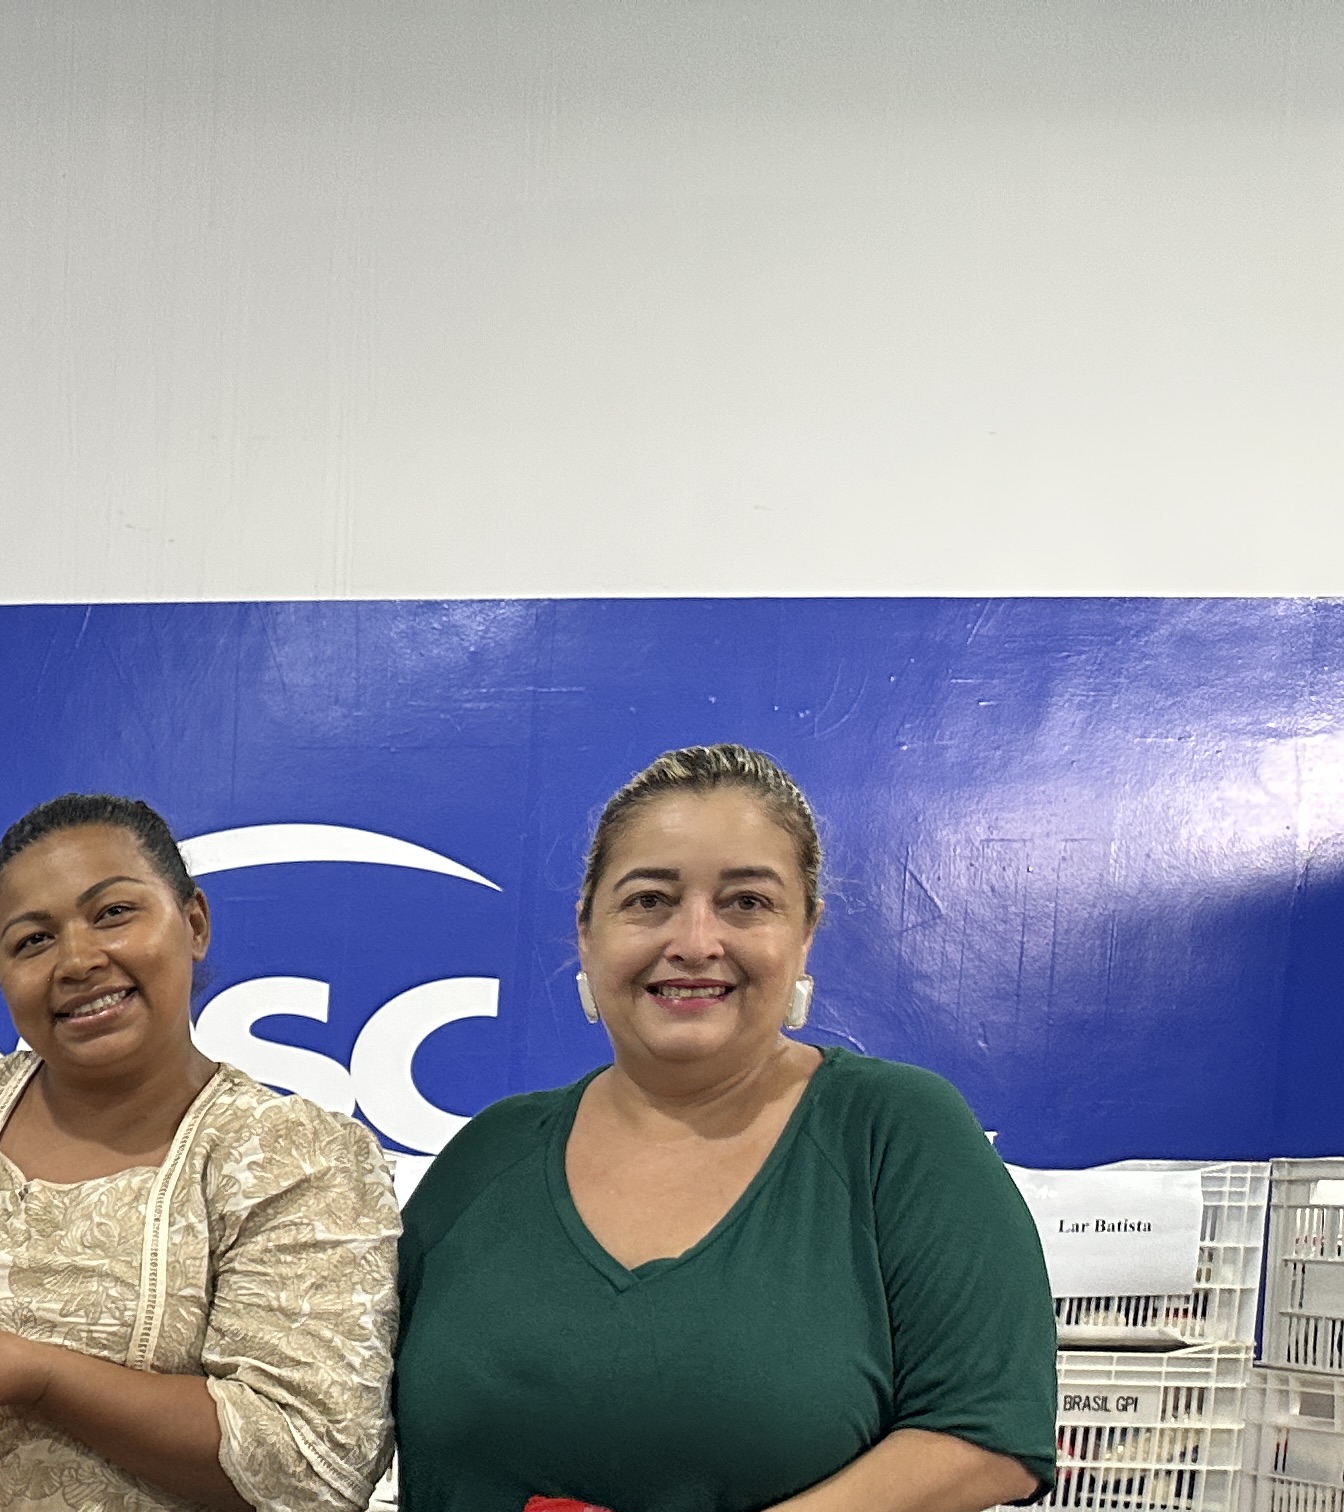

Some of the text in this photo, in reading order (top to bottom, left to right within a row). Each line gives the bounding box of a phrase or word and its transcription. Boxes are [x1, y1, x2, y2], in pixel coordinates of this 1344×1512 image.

[1058, 1217, 1153, 1234] Lar Batista
[1063, 1394, 1139, 1413] BRASIL GPI
